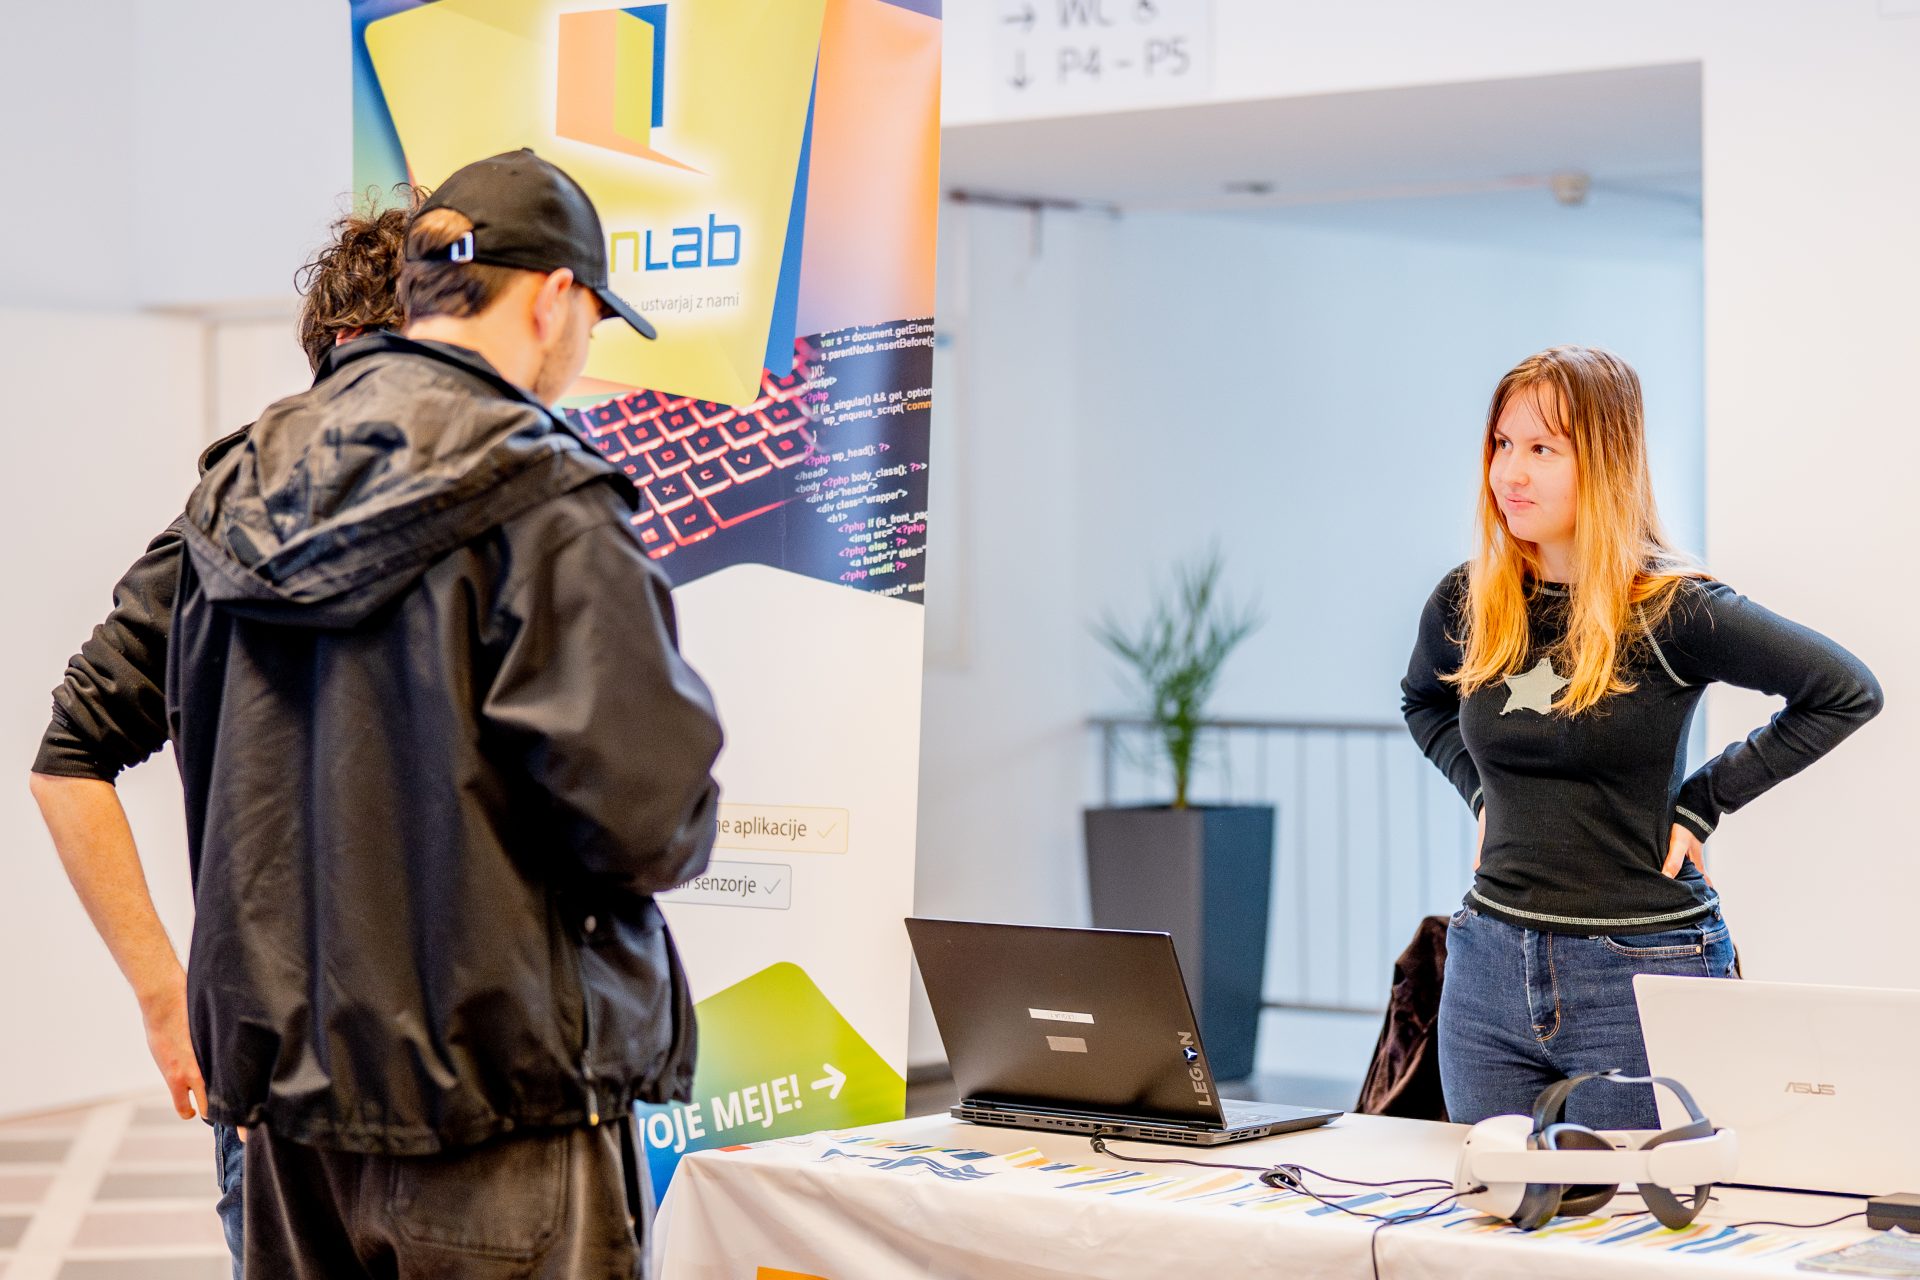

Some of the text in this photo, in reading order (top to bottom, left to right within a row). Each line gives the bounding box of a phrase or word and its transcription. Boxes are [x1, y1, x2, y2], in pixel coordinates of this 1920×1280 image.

[1057, 46, 1102, 83] P4
[1144, 36, 1191, 76] P5
[641, 295, 693, 313] ustvarjaj
[696, 298, 703, 308] z
[706, 292, 740, 308] nami
[820, 338, 835, 348] var
[836, 336, 843, 345] s
[794, 467, 829, 481] </head>
[795, 481, 820, 494] <body
[822, 475, 849, 488] <?php
[805, 492, 823, 504] <div
[816, 502, 835, 514] <div
[826, 513, 848, 523] <h1>
[837, 521, 866, 534] <?php
[867, 517, 874, 528] if
[848, 532, 872, 543] <img
[838, 545, 867, 558] <?php
[868, 541, 888, 552] else
[896, 537, 908, 547] ?>
[849, 558, 862, 567] <a
[839, 569, 868, 582] <?php
[734, 816, 807, 841] aplikacije
[694, 875, 757, 897] senzorje
[1784, 1081, 1836, 1096] ASUS
[711, 1074, 803, 1132] MEJE!
